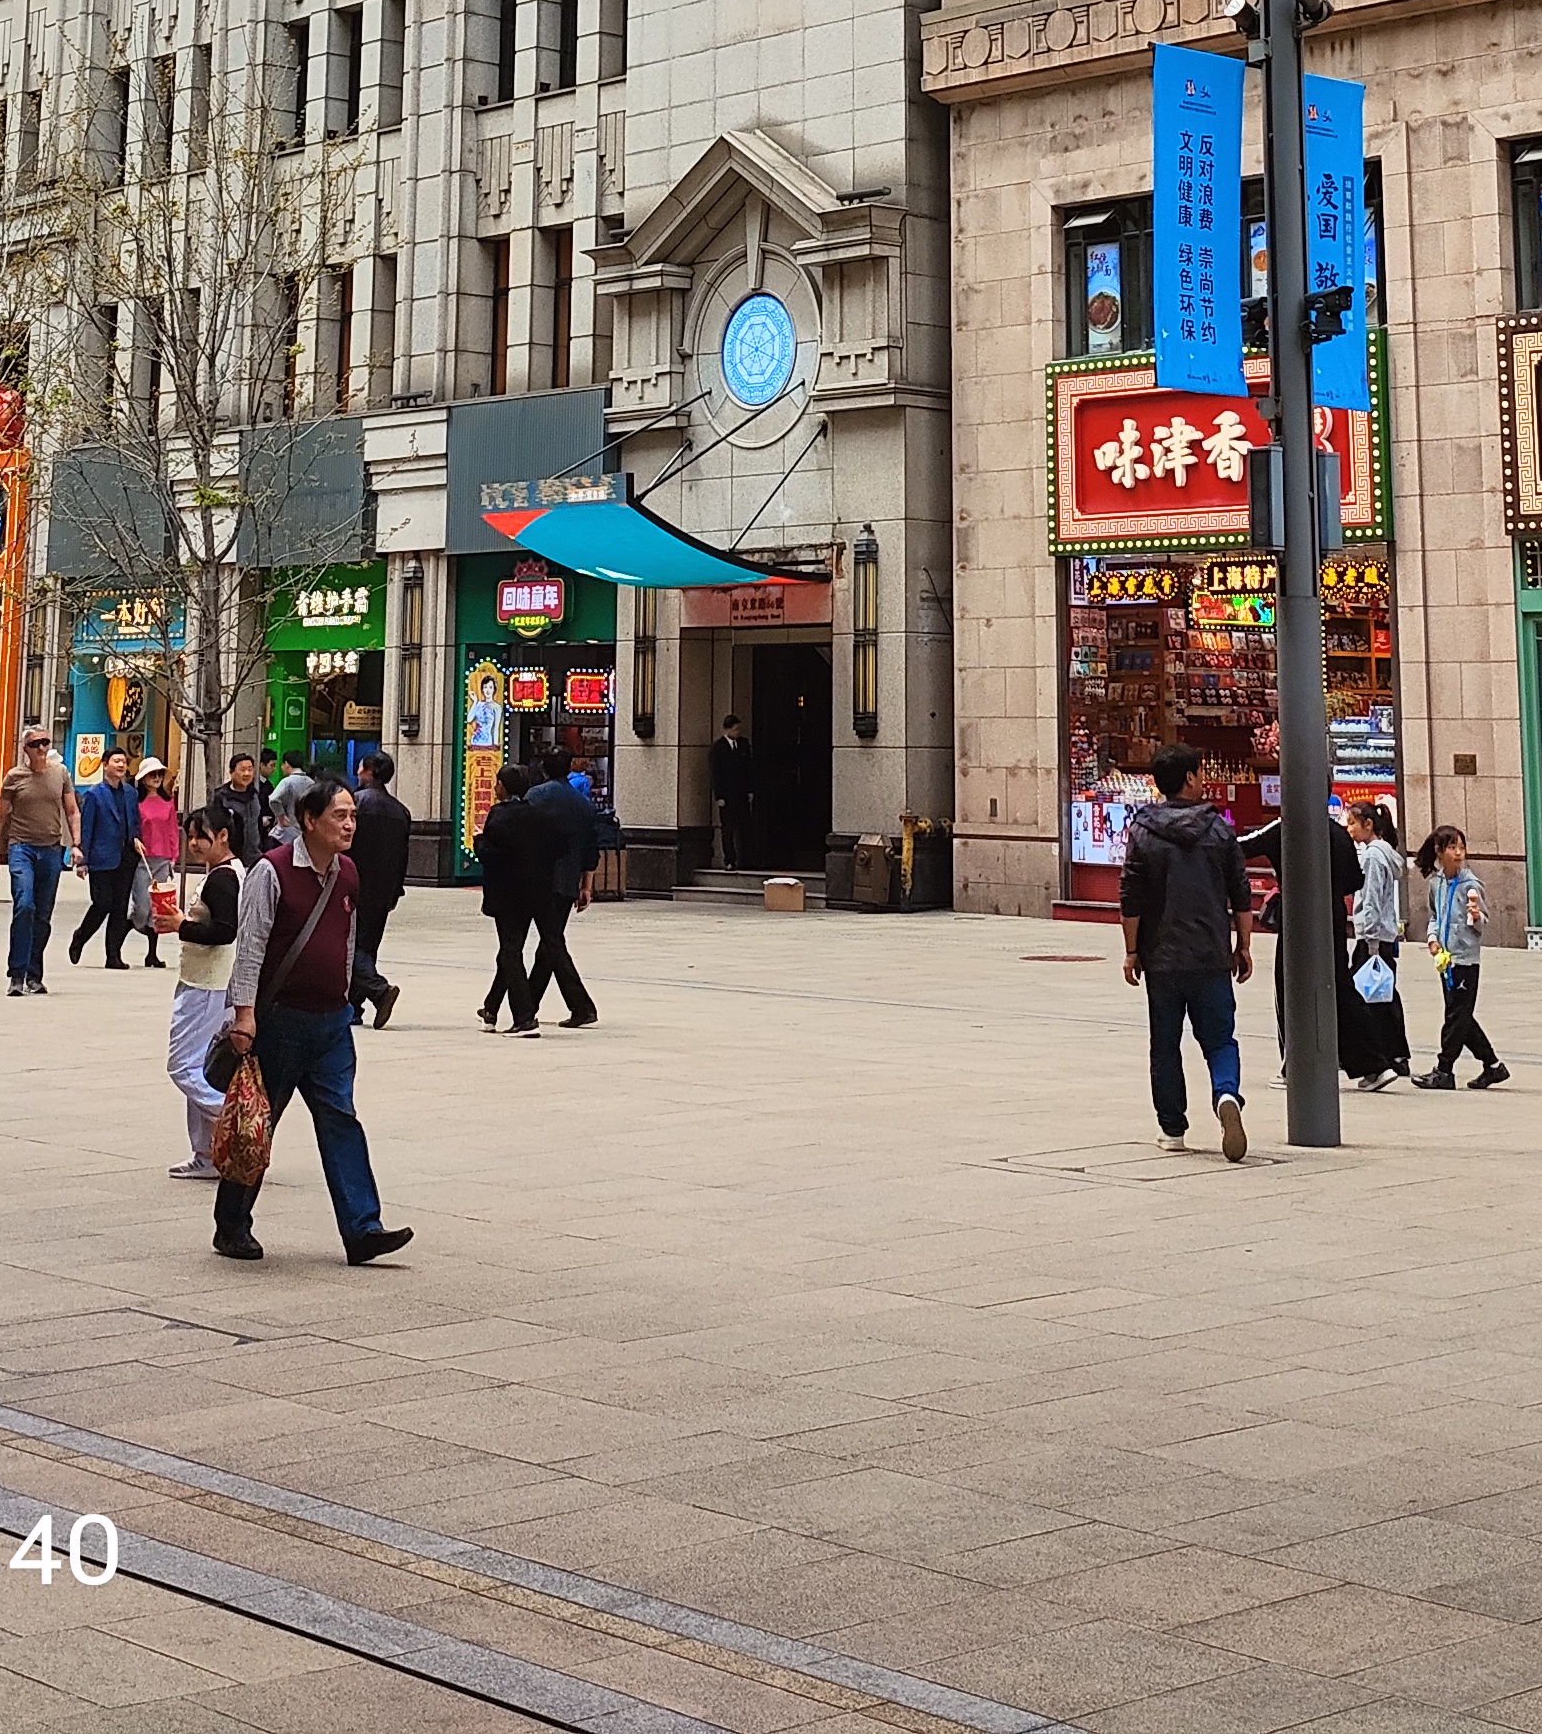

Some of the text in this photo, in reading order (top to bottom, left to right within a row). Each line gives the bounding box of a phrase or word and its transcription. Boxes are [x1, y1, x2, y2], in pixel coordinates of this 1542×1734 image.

[1197, 133, 1214, 232] 反对浪费
[1316, 172, 1340, 242] 爱国
[1177, 129, 1197, 342] 文明健康 绿色环保
[1198, 246, 1217, 346] 崇尚节约
[1093, 410, 1254, 489] 味津香
[501, 584, 559, 611] 回味童年
[1210, 564, 1277, 592] 上海特产
